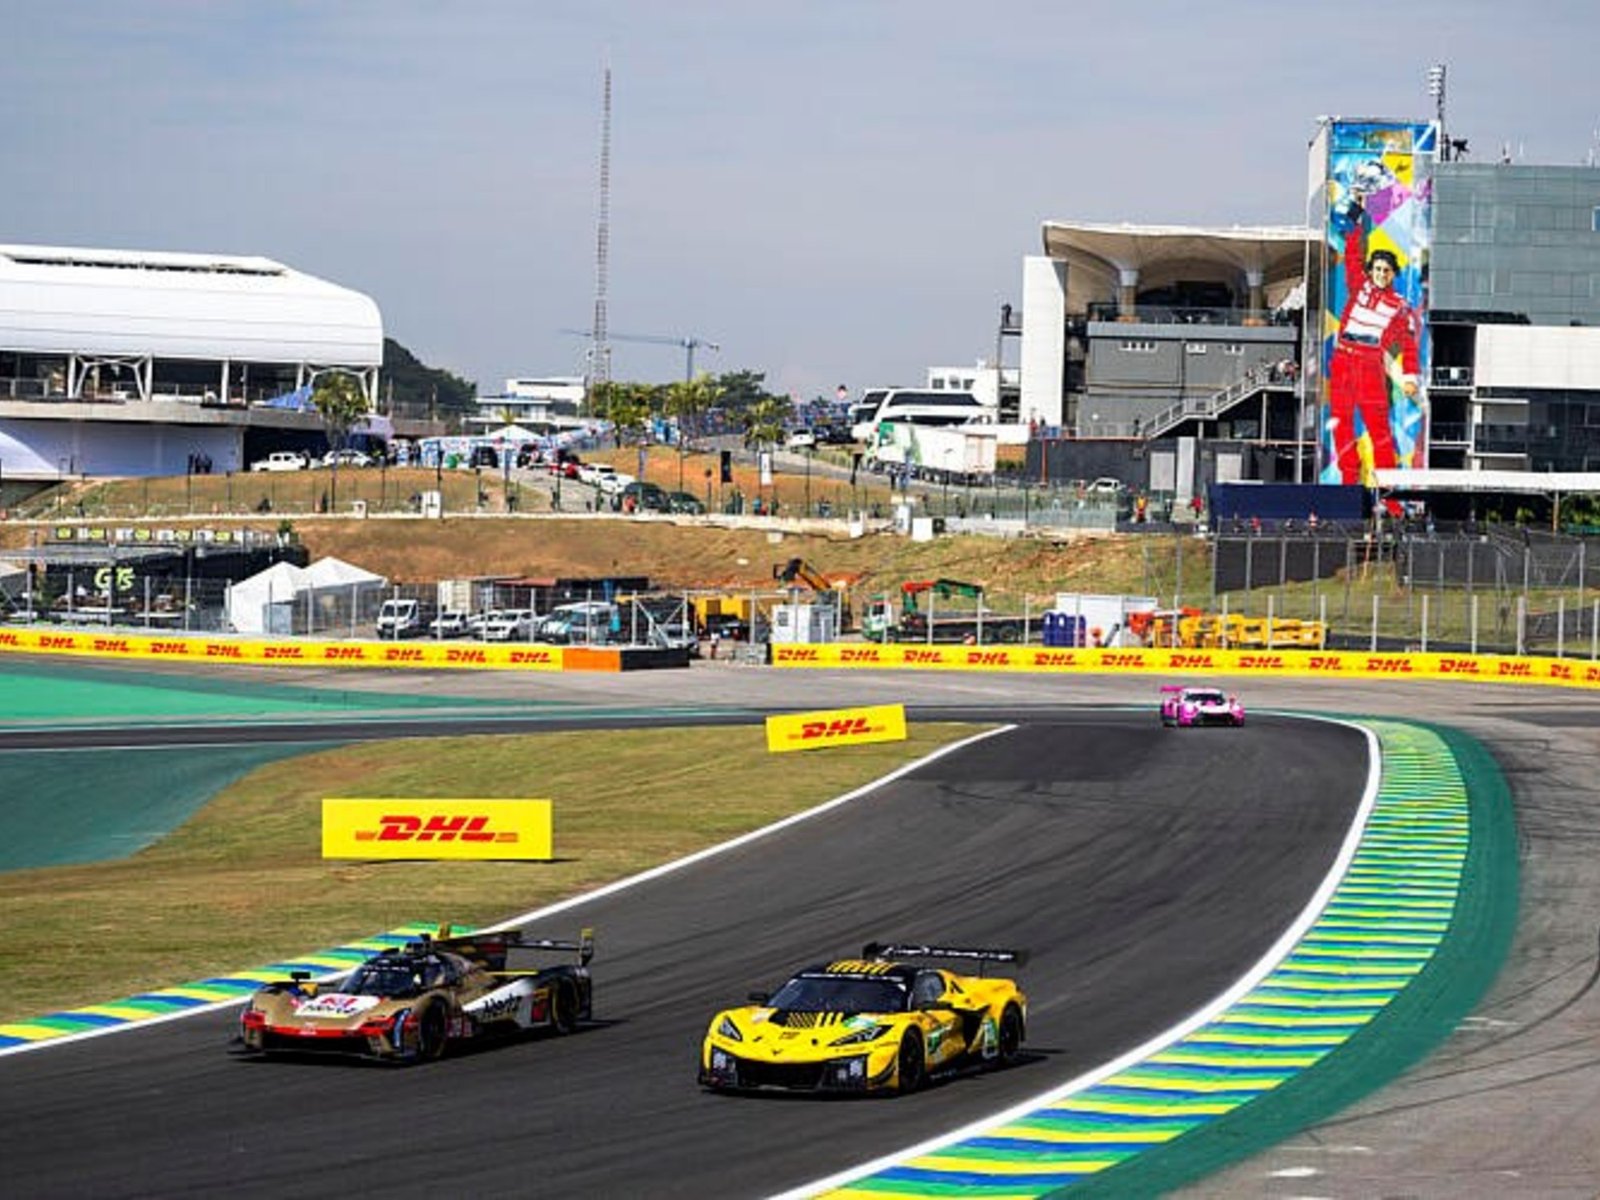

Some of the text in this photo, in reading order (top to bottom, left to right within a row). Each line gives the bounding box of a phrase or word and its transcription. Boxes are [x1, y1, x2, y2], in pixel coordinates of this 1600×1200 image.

[39, 635, 76, 648] DHL
[94, 640, 130, 652] DHL
[150, 643, 187, 655] DHL
[206, 645, 242, 657] DHL
[264, 647, 304, 659] DHL
[324, 648, 362, 660] DHL
[386, 649, 424, 661] DHL
[778, 649, 817, 661] DHL
[447, 651, 486, 662] DHL
[510, 652, 551, 664] DHL
[839, 650, 880, 662] DHL
[903, 650, 943, 662] DHL
[966, 652, 1010, 665] DHL
[1033, 653, 1076, 666] DHL
[1101, 654, 1146, 667] DHL
[1169, 654, 1213, 668] DHL
[1238, 656, 1284, 669] DHL
[1366, 658, 1413, 673] DHL
[1440, 660, 1481, 674] DHL
[1498, 662, 1532, 676] DHL
[802, 719, 872, 739] DHL
[377, 815, 496, 842] DHL
